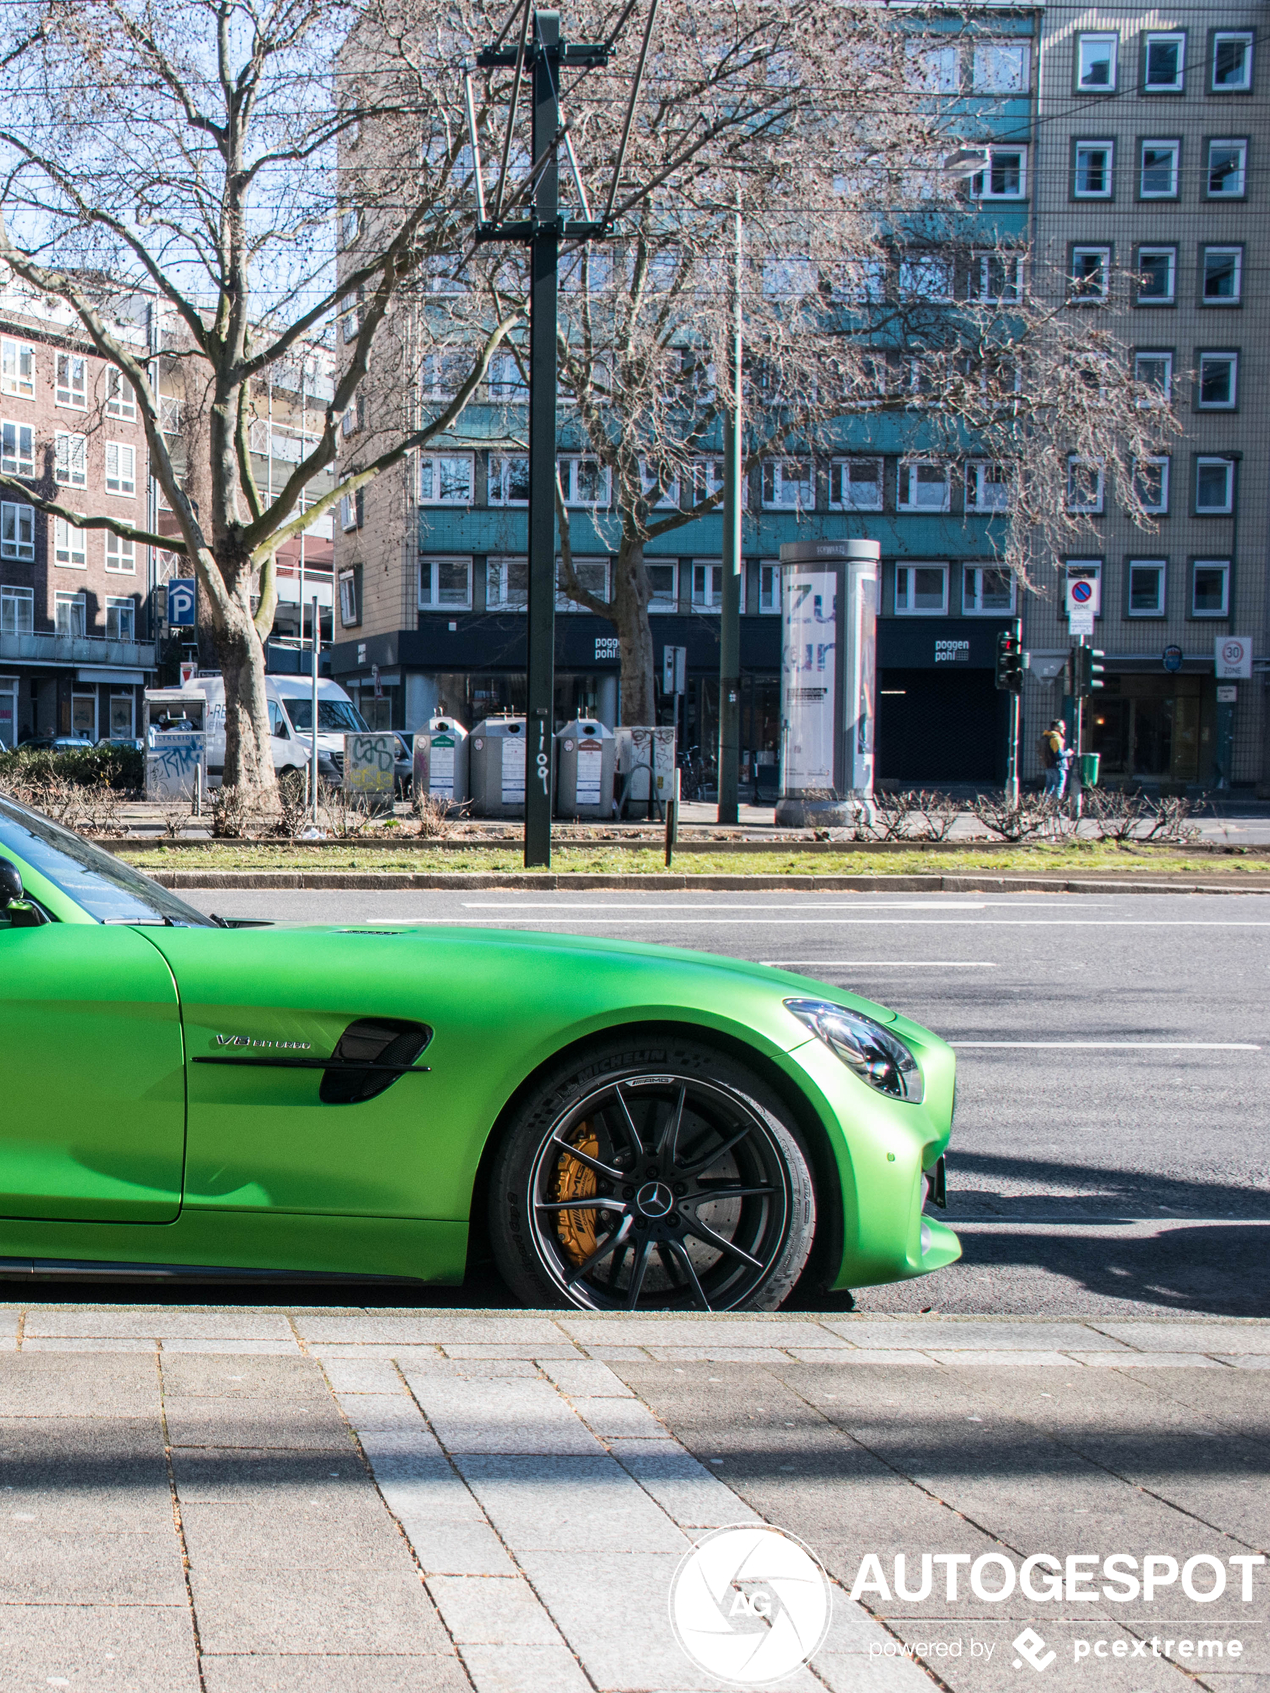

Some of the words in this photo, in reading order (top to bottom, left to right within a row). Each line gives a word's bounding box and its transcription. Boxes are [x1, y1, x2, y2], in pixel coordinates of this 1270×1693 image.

[173, 594, 192, 622] P
[935, 640, 970, 651] poggen
[595, 648, 616, 659] pohl
[935, 650, 956, 661] pohl
[1226, 647, 1240, 658] 30
[1224, 666, 1242, 675] ZONE
[216, 1034, 250, 1046] V8
[253, 1039, 311, 1050] BITURBO
[577, 1050, 668, 1080] MICHELIN
